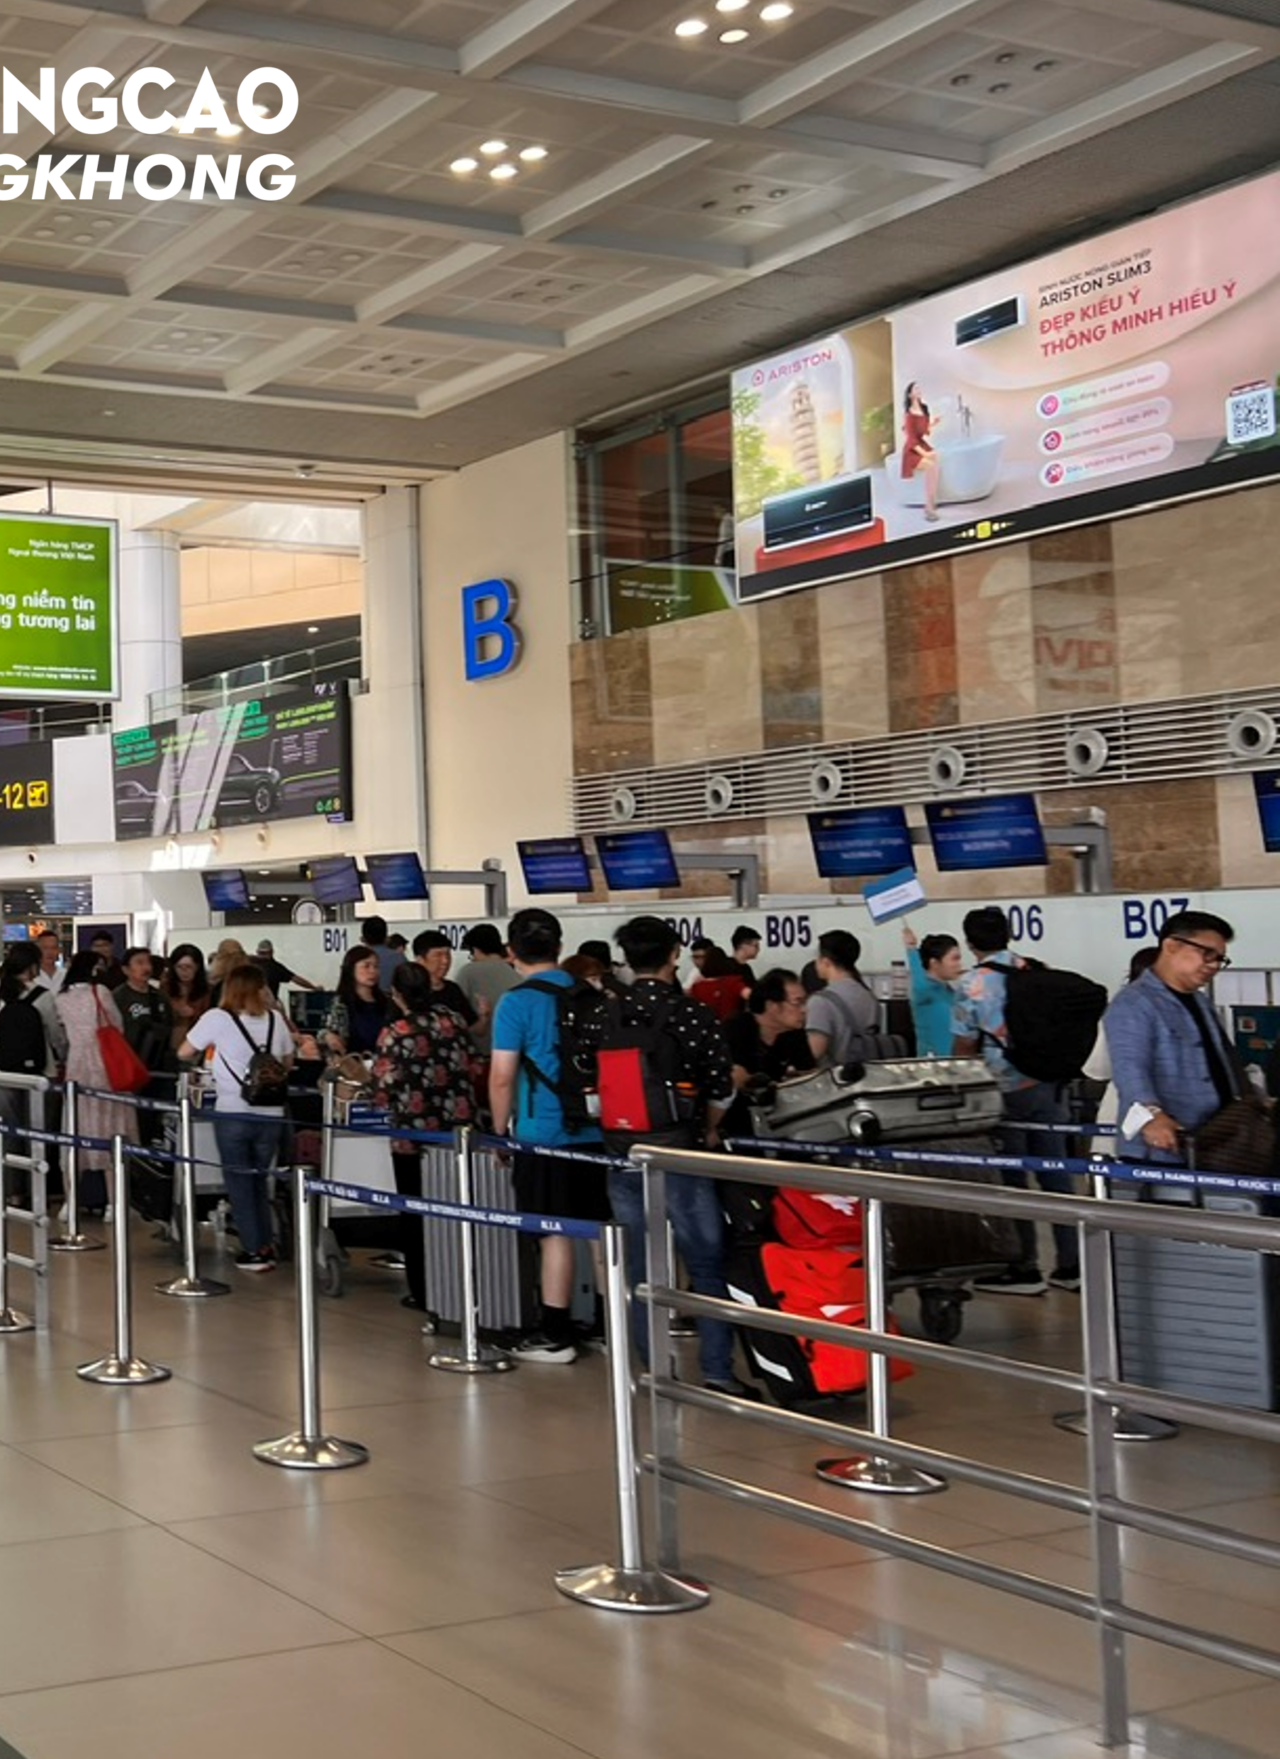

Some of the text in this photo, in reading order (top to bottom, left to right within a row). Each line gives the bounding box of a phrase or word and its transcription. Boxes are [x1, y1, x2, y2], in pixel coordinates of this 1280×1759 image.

[1039, 260, 1152, 309] ARISTON SLIM3
[1039, 309, 1076, 335] ĐẸP
[1128, 286, 1141, 305] Ý
[1040, 325, 1107, 357] THÔNG
[1111, 306, 1163, 335] MINH
[768, 349, 833, 380] ARISTON
[71, 594, 95, 611] tin
[17, 612, 70, 633] tương
[75, 613, 96, 631] lai
[461, 578, 520, 681] B
[323, 928, 348, 952] B01
[766, 914, 812, 947] B05
